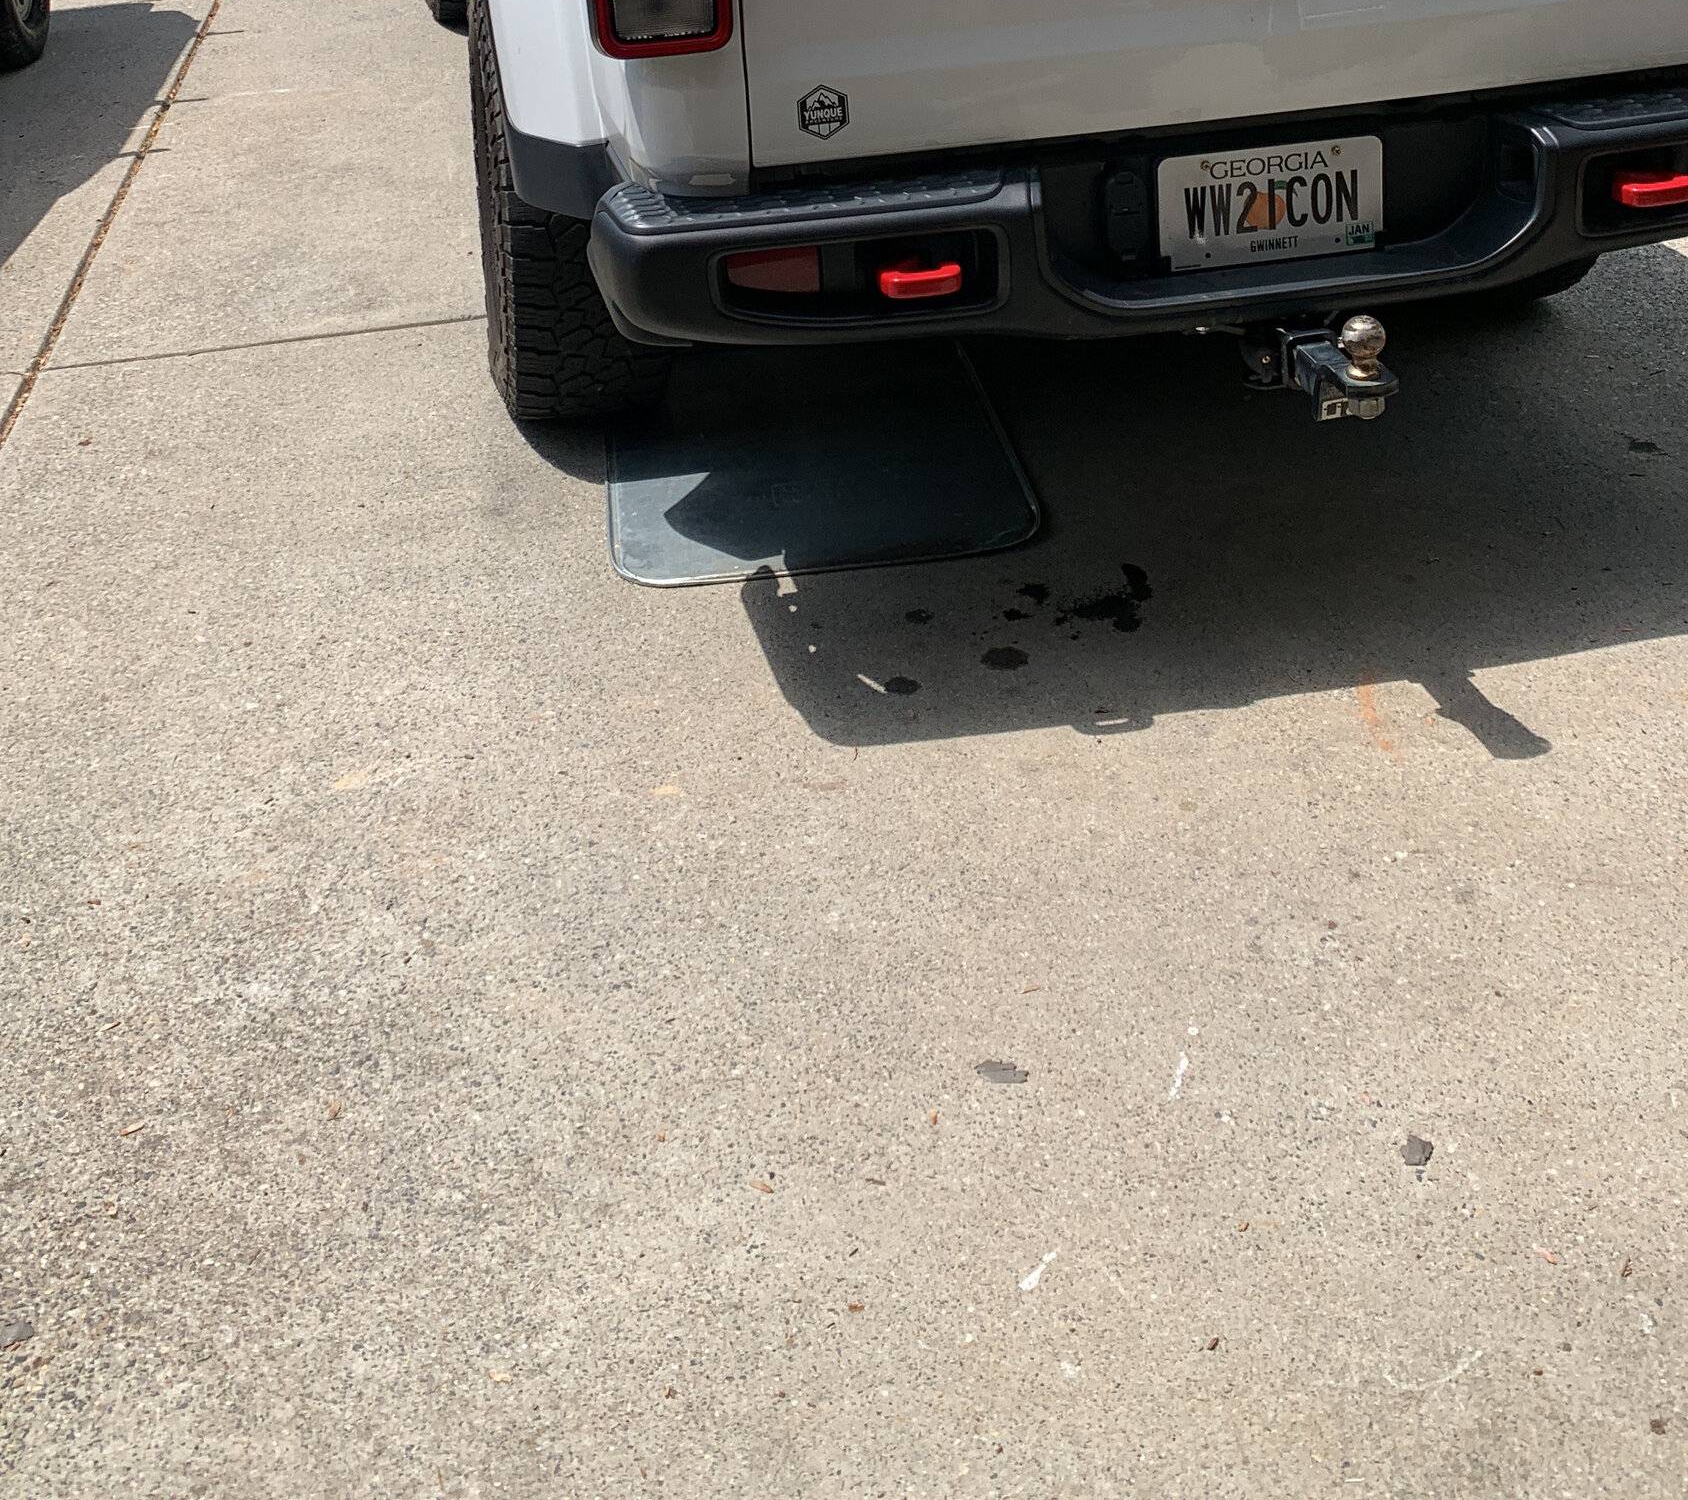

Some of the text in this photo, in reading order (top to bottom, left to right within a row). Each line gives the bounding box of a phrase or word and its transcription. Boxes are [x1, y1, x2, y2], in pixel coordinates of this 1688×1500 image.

[803, 106, 844, 121] YUNQUE
[1209, 151, 1329, 180] GEORGIA
[1348, 223, 1370, 236] JAN
[1250, 235, 1299, 253] GWINNETT
